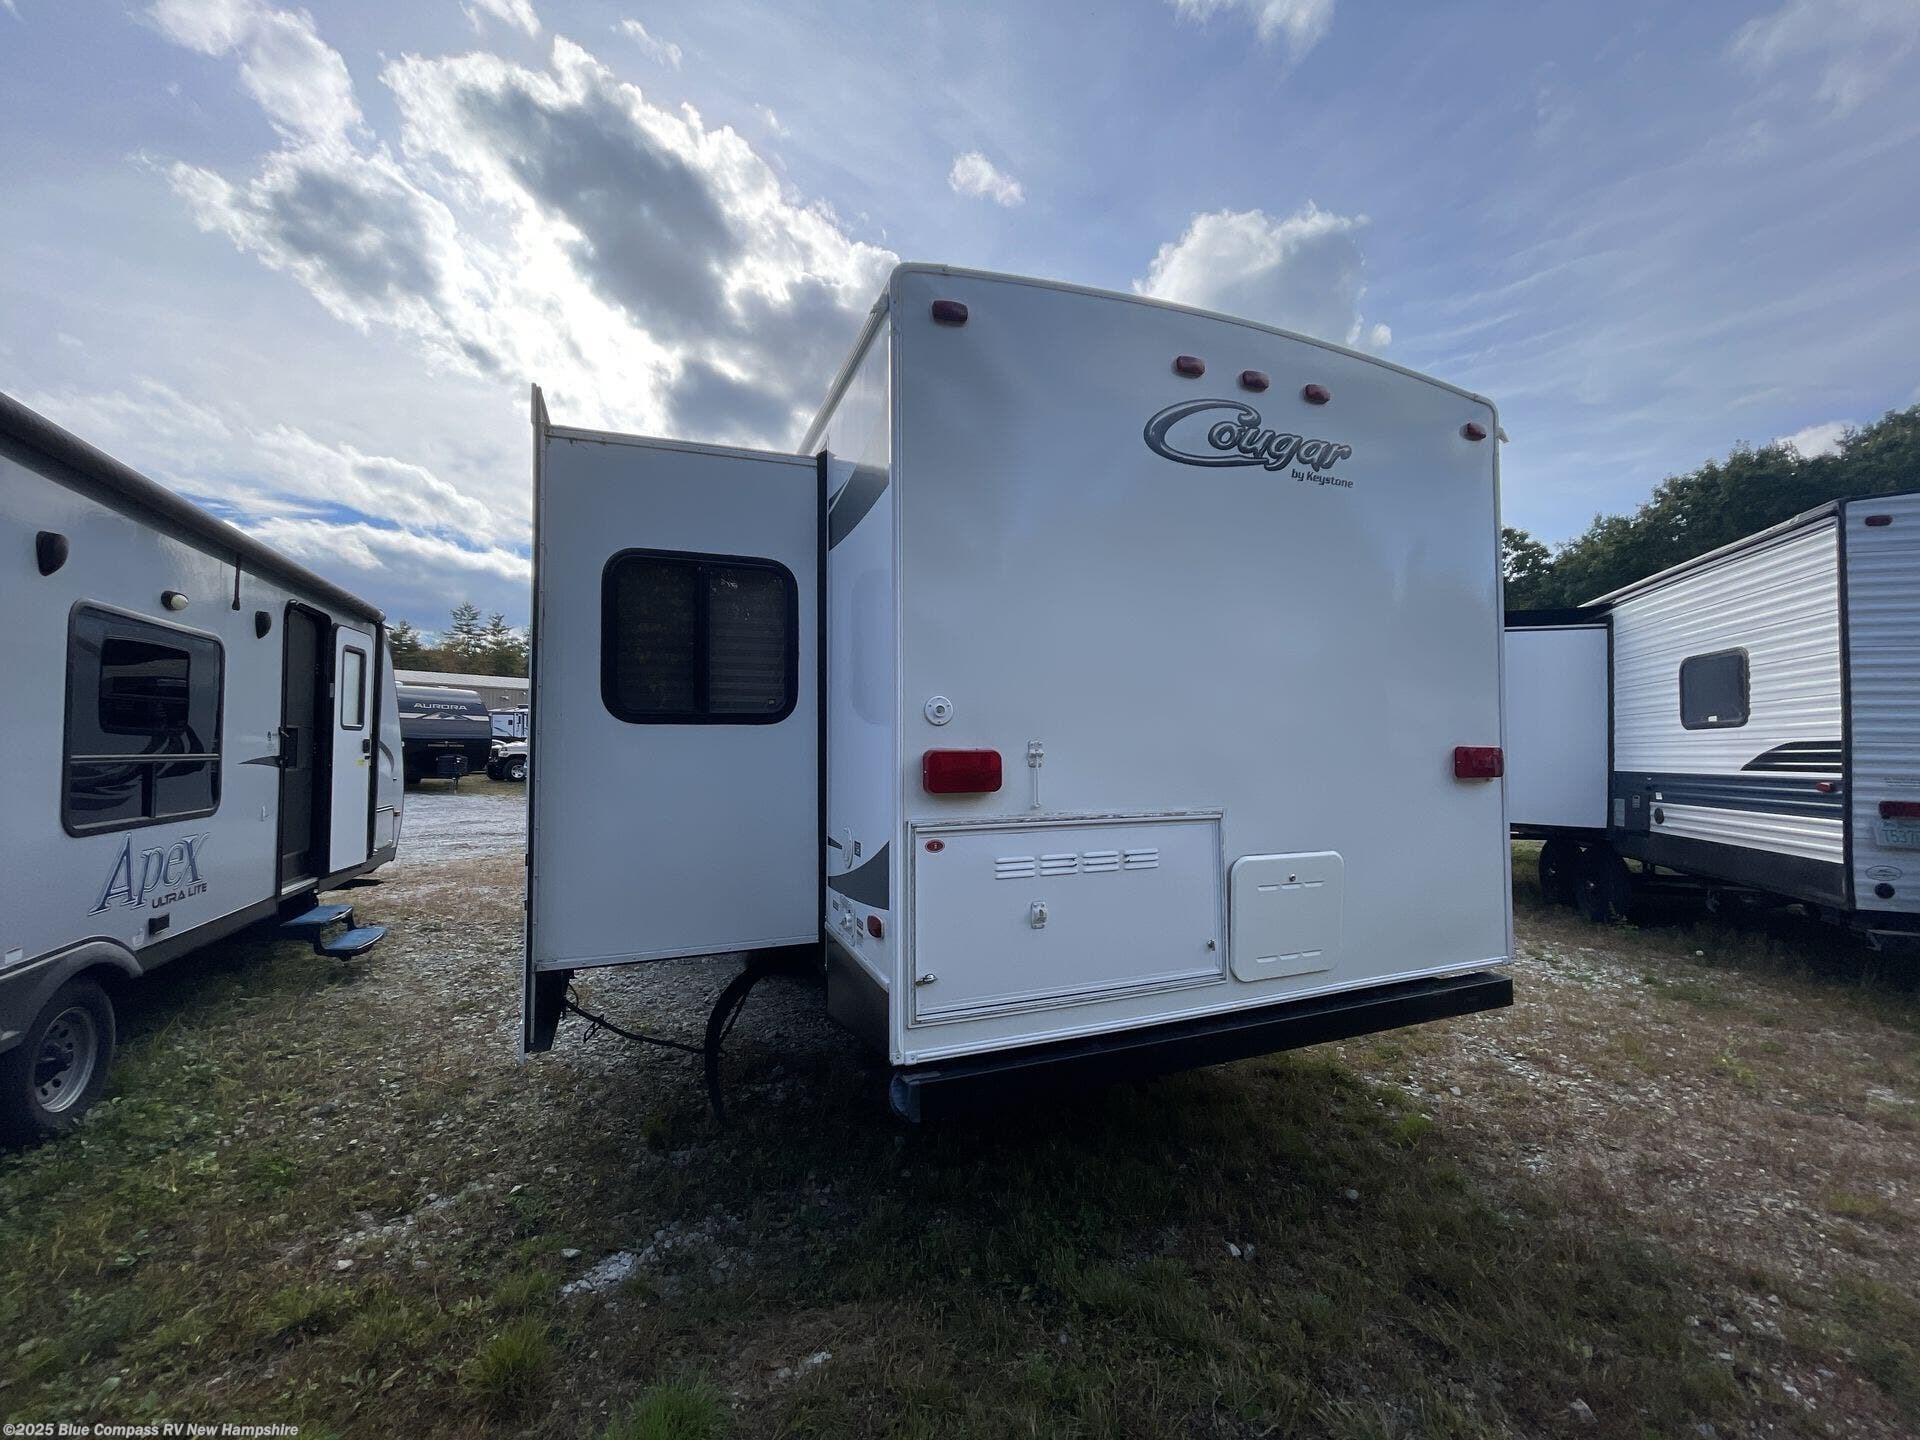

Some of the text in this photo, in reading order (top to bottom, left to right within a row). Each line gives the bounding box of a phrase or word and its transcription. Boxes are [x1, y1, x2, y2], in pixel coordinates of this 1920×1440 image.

[1143, 398, 1352, 472] Cougar
[1291, 469, 1354, 488] by Keystone
[413, 702, 467, 711] AURORA
[152, 882, 208, 909] ULTRA LITE
